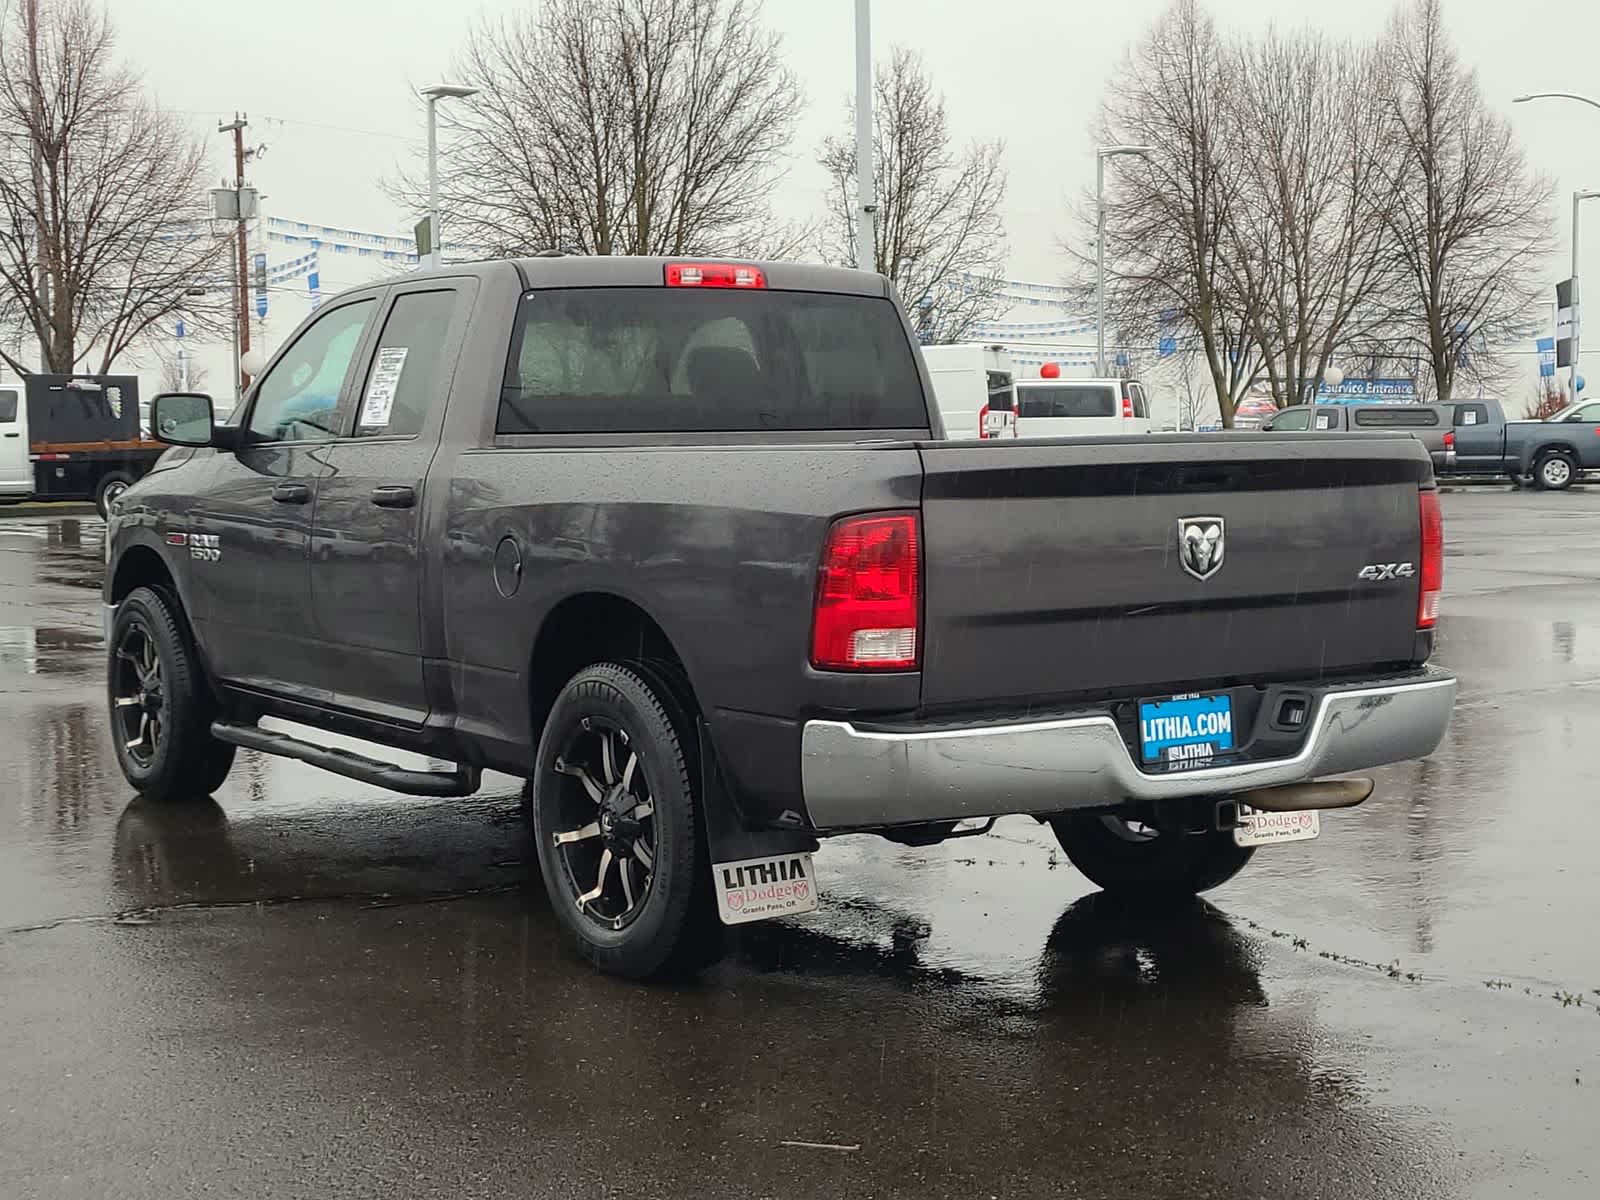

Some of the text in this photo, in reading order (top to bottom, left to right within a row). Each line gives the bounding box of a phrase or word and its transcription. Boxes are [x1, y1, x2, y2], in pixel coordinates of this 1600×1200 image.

[1325, 381, 1413, 394] Service Entrance
[1142, 711, 1231, 742] LITHIA.COM
[1179, 742, 1214, 759] LITHIA
[1257, 815, 1298, 829] Dodge
[1254, 831, 1274, 839] Grants
[723, 858, 806, 889] LITHIA
[745, 885, 792, 902] Dodge
[742, 904, 765, 914] Grants
